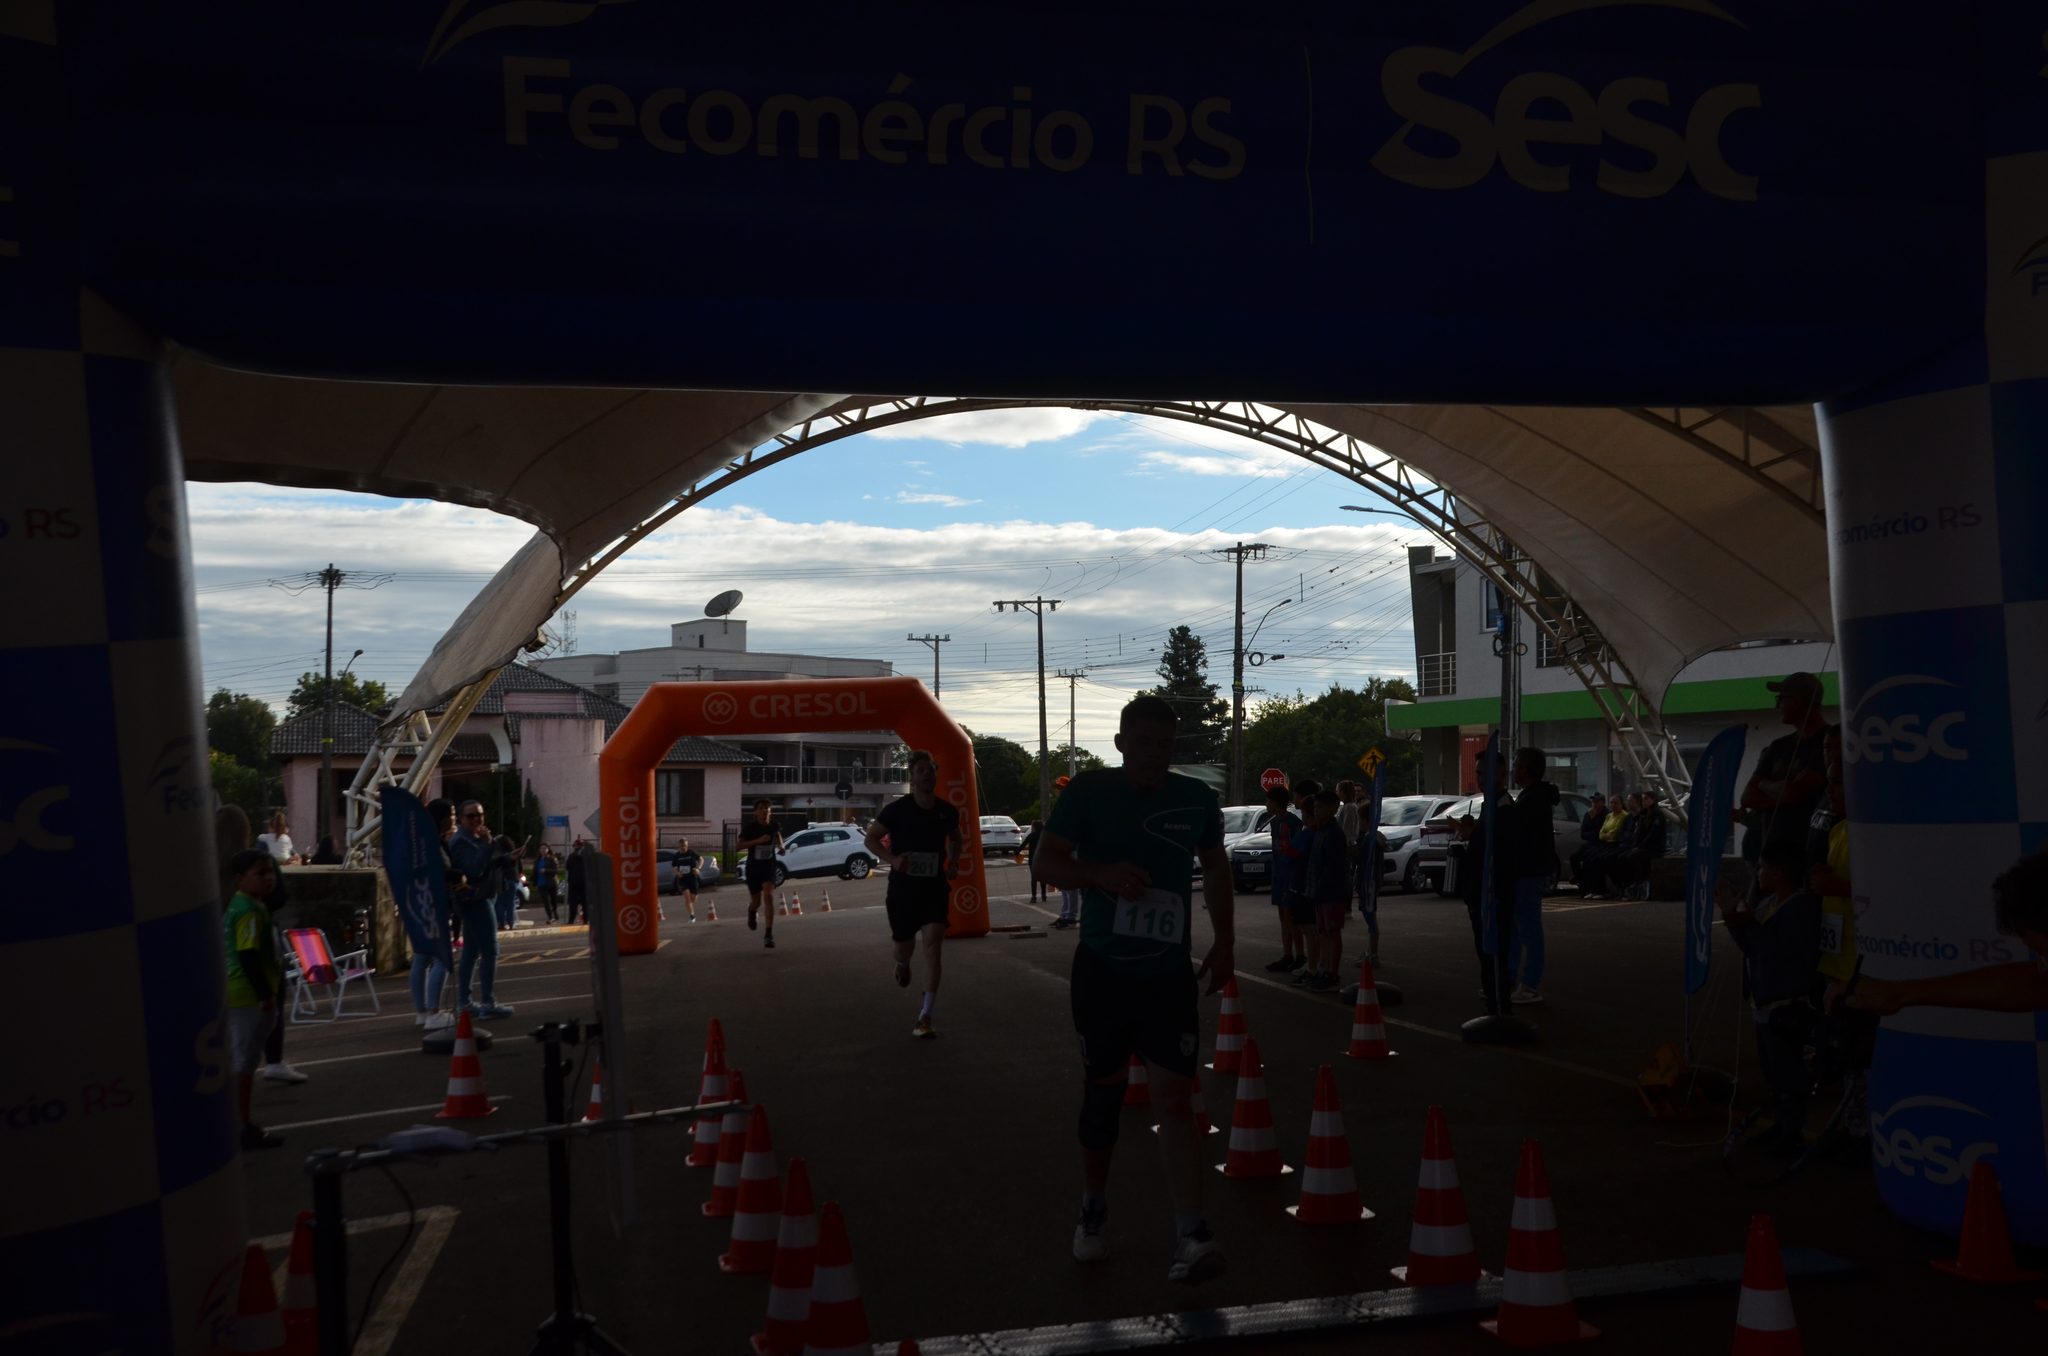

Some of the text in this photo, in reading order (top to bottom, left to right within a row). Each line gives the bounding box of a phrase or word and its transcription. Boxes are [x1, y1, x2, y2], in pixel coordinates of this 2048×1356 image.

[501, 54, 1247, 181] Fecomércio RS
[1369, 44, 1764, 202] Sesc
[25, 507, 82, 540] RS
[1937, 502, 1983, 530] RS
[749, 690, 880, 719] CRESOL
[1262, 777, 1284, 785] PARE
[618, 787, 642, 896] CRESOL
[911, 862, 935, 875] 201
[1125, 905, 1176, 938] 116
[1968, 938, 2013, 963] RS
[81, 1075, 136, 1117] RS
